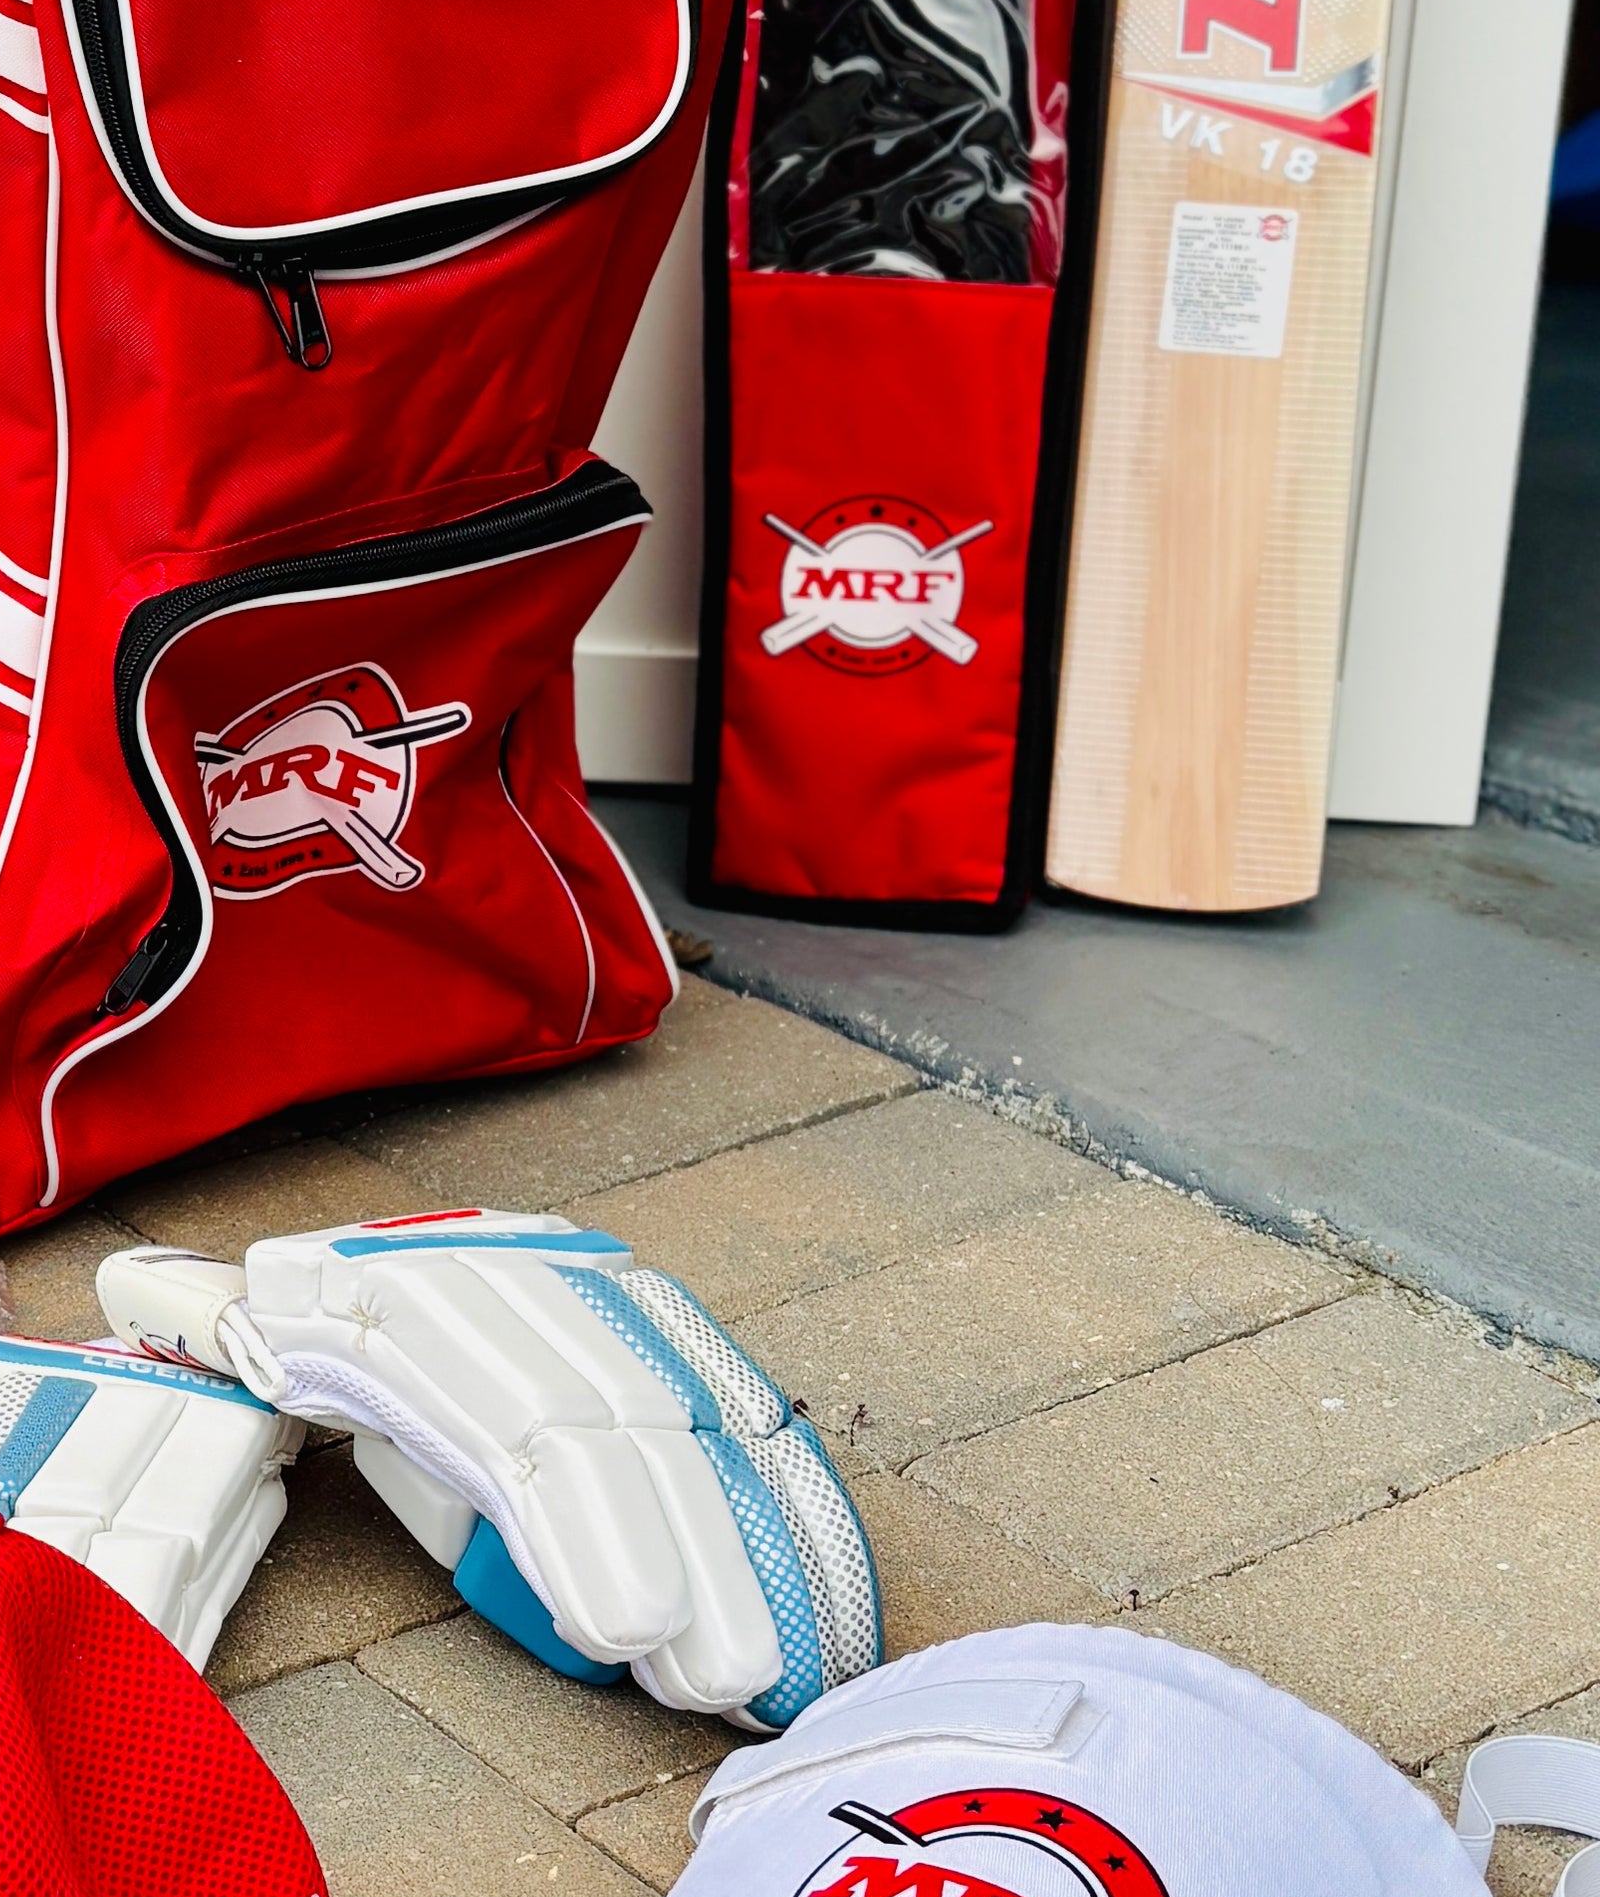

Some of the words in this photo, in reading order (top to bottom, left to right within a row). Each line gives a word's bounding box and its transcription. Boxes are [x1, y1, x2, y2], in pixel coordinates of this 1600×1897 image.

[1157, 103, 1233, 156] VK
[1258, 139, 1319, 184] 18
[790, 567, 956, 604] MRF
[206, 744, 401, 819] MRF
